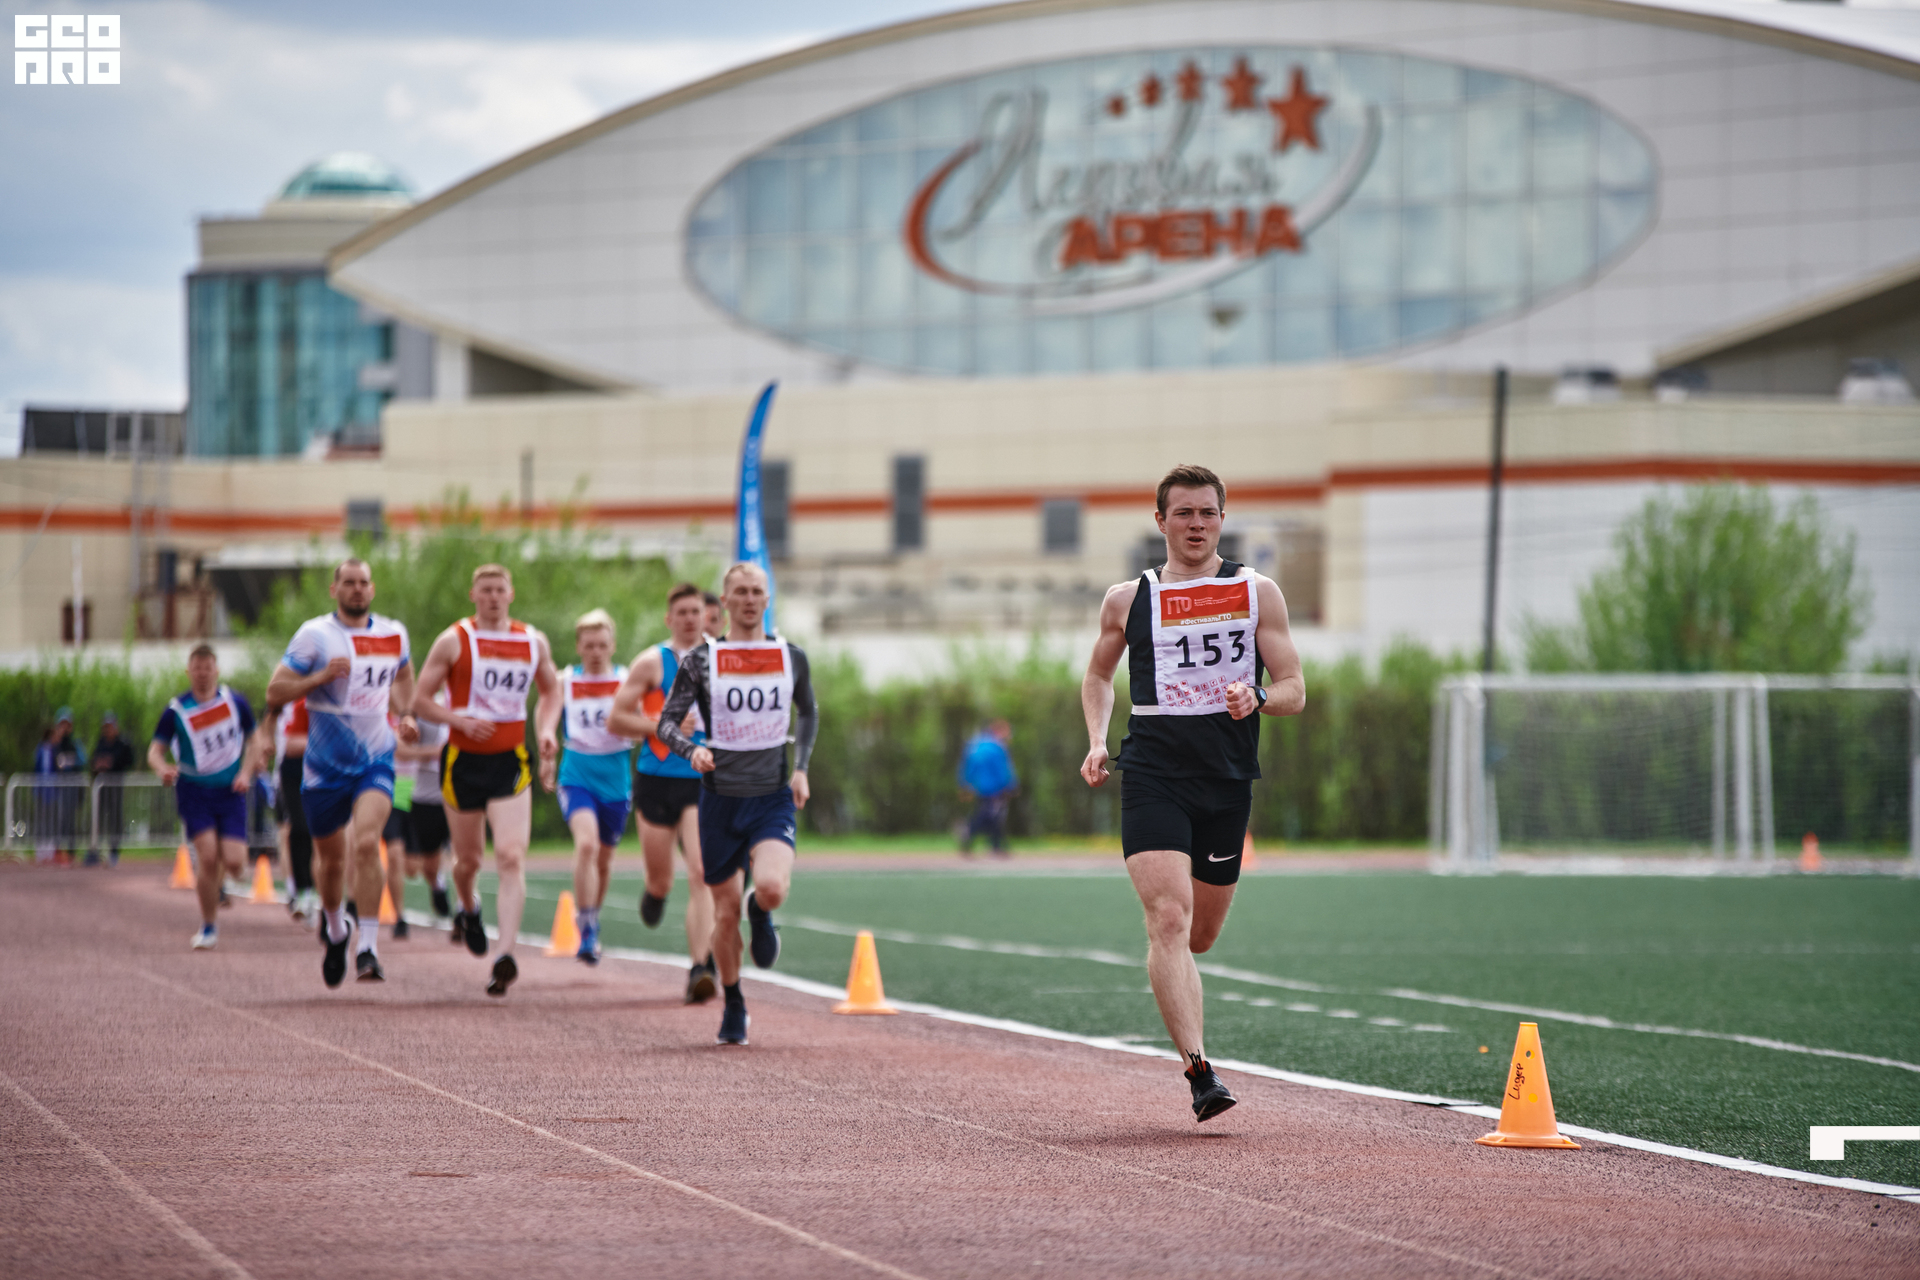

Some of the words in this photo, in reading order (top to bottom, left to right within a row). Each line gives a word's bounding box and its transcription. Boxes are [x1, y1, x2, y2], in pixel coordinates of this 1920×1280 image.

[1060, 205, 1306, 271] АРЕНА
[1166, 596, 1193, 615] ГТО
[1175, 630, 1246, 669] 153
[484, 667, 529, 693] 042
[726, 686, 783, 713] 001
